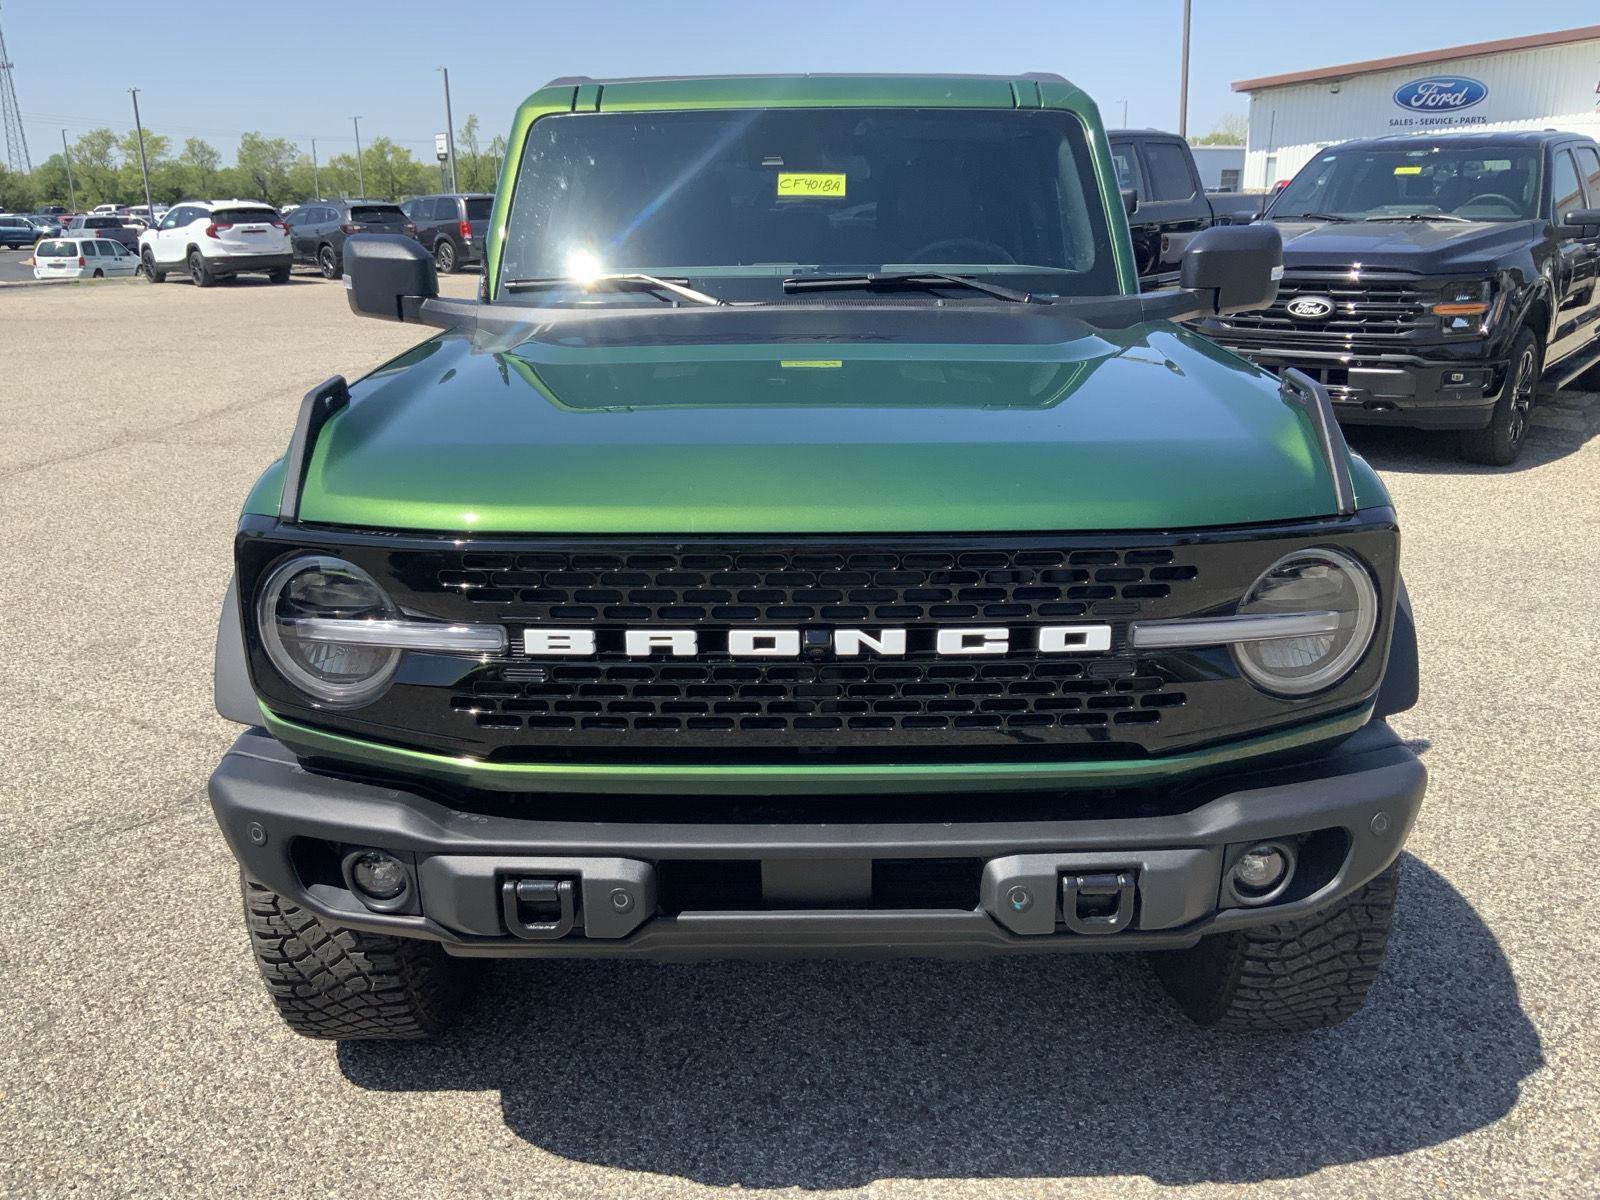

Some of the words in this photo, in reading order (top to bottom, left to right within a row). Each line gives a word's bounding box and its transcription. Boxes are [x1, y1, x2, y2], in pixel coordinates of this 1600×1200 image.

[1411, 82, 1467, 107] Ford
[1389, 118, 1414, 127] SALES
[1419, 117, 1453, 126] SERVICE
[1460, 116, 1487, 124] PARTS
[779, 178, 841, 192] CF4018A
[1295, 302, 1322, 313] Ford
[523, 626, 1112, 656] BRONCO
